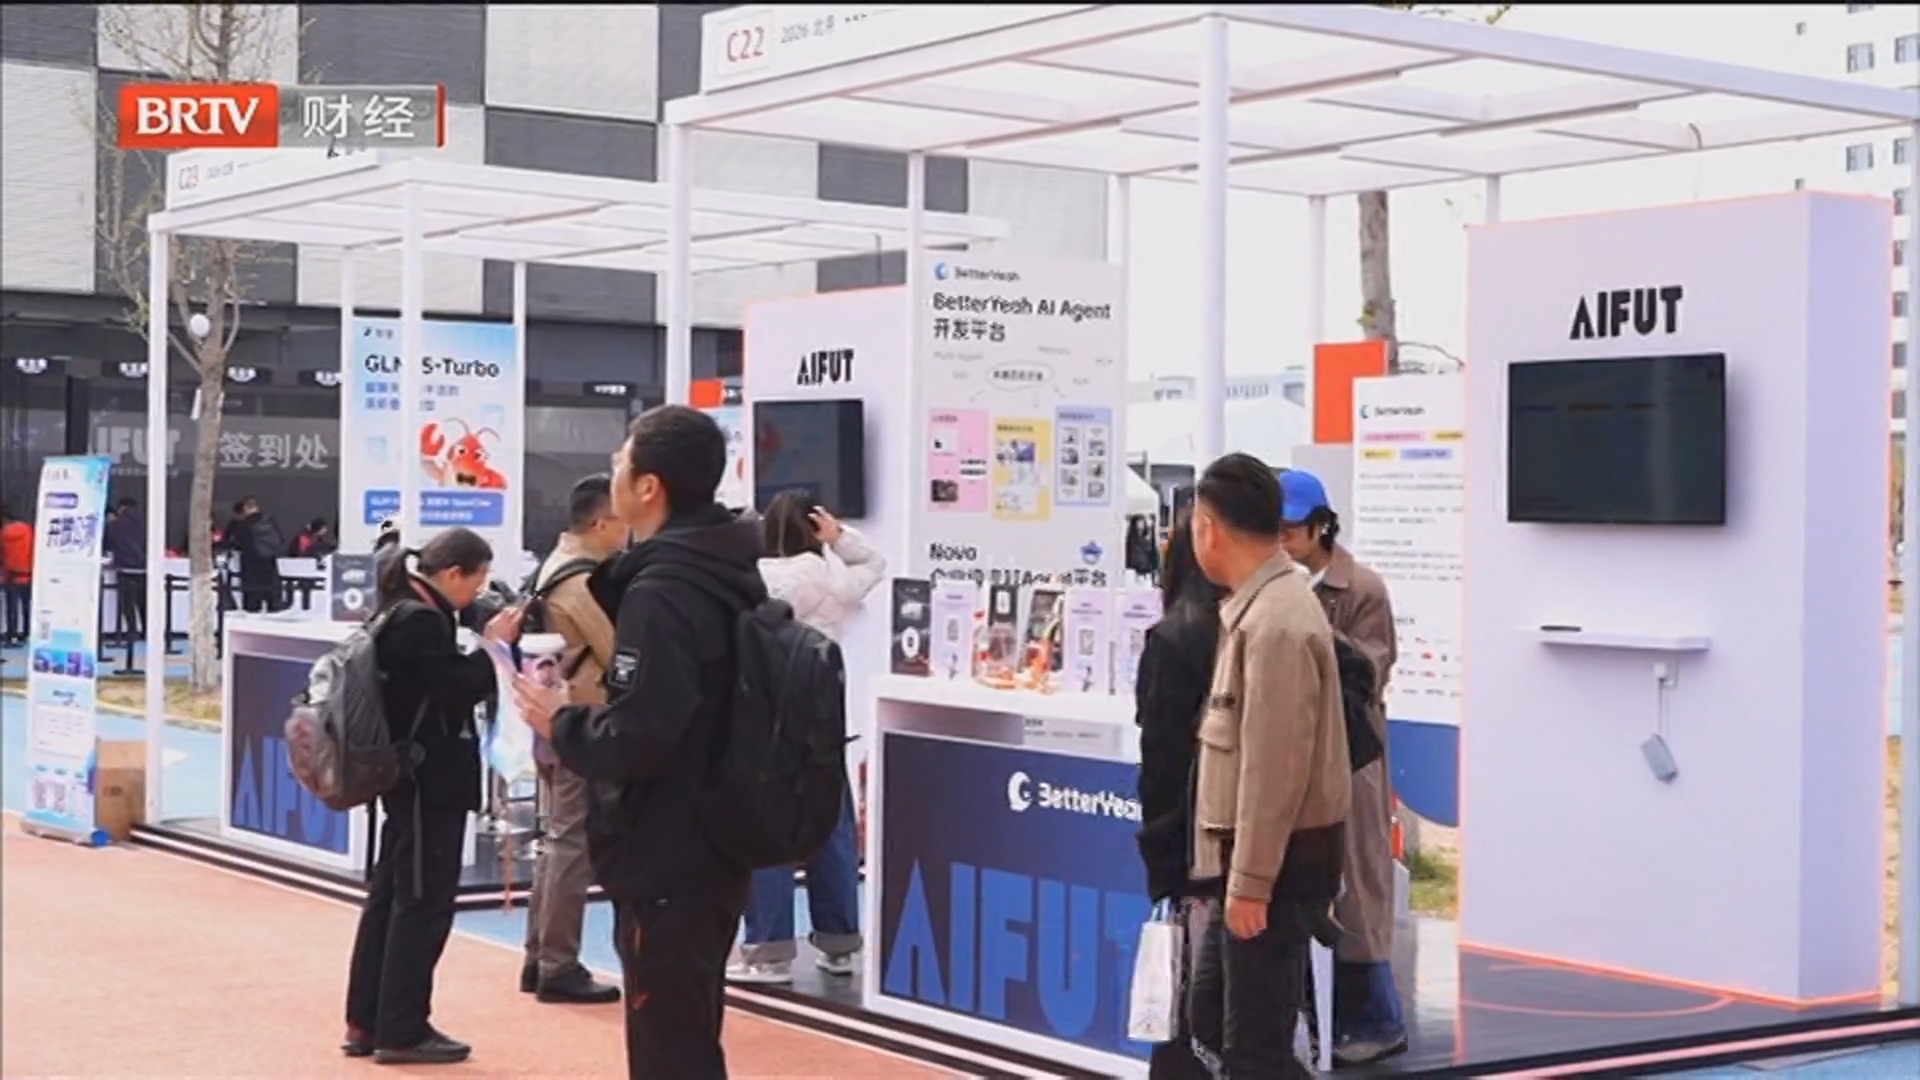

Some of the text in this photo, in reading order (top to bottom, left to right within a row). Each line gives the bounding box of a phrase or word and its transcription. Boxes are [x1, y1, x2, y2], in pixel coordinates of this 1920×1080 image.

[727, 26, 765, 62] C22
[933, 292, 1111, 323] BetterYeah AI Agent
[1569, 284, 1684, 341] AIFUT
[933, 318, 1006, 342] 开发平台
[797, 347, 855, 386] AIFUT
[88, 427, 180, 465] IFUT
[219, 431, 328, 469] 签到处
[1038, 782, 1143, 822] BetterYea
